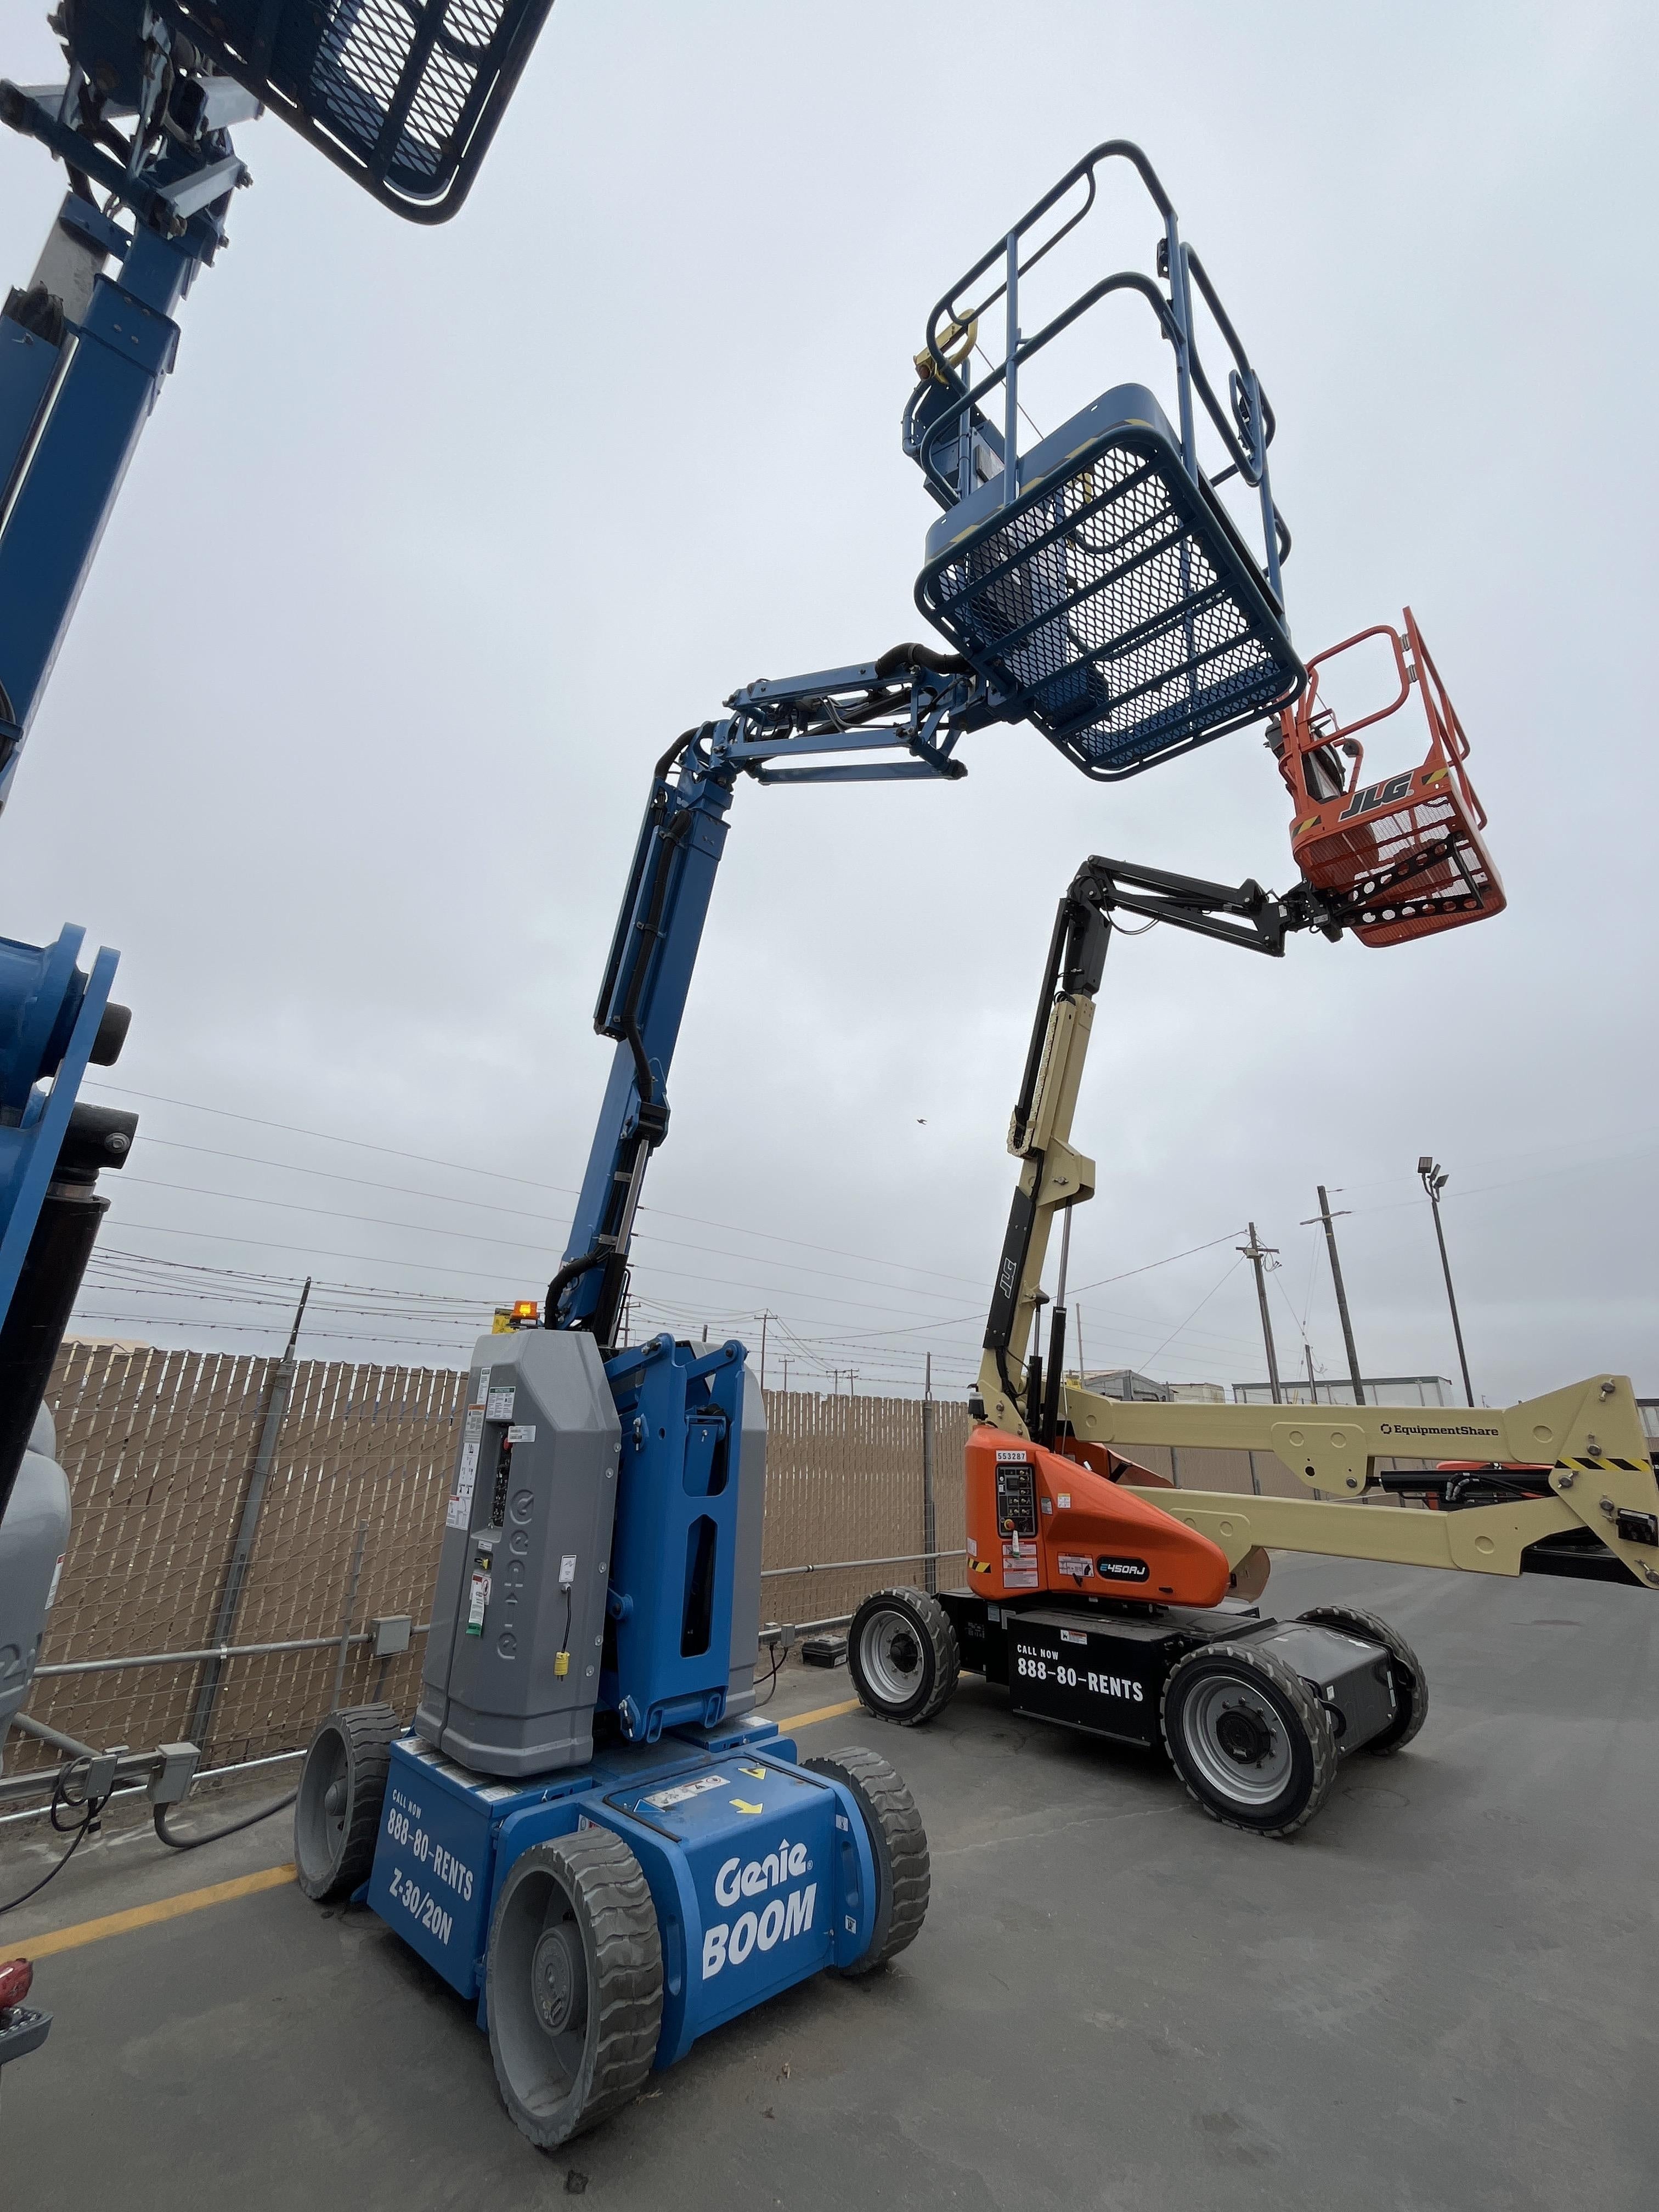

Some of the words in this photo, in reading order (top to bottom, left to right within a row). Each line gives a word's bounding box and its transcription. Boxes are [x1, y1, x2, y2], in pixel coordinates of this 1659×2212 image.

[1339, 771, 1414, 822] JLG
[1000, 1257, 1016, 1299] JLG
[1393, 1424, 1499, 1436] EquipmentShare
[1100, 1564, 1145, 1575] E450AJ
[1017, 1644, 1037, 1656] CALL
[1040, 1649, 1058, 1660] NOW
[1018, 1657, 1143, 1701] 888-80-RENTS
[392, 1789, 407, 1809] CALL
[408, 1801, 422, 1820] NOW
[387, 1808, 474, 1901] 888-80-RENTS
[715, 1838, 808, 1907] Genie
[388, 1867, 453, 1945] Z-30/20N
[703, 1883, 817, 1980] BOOM
